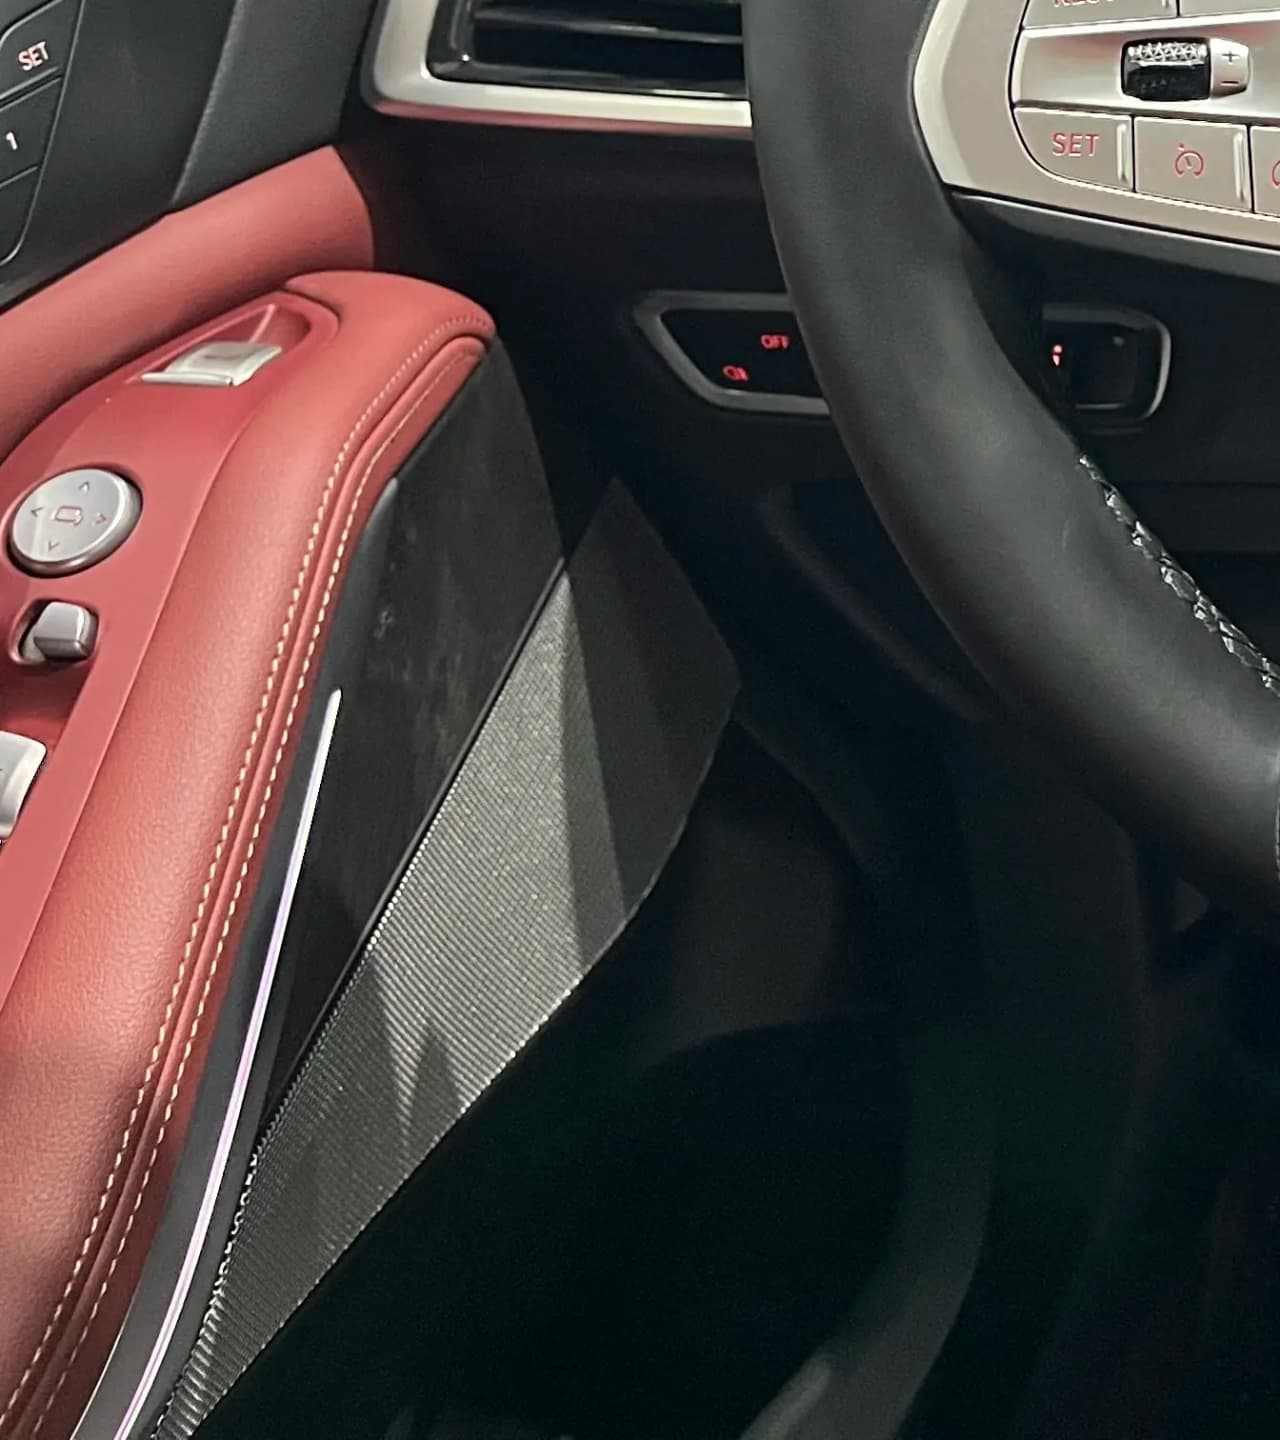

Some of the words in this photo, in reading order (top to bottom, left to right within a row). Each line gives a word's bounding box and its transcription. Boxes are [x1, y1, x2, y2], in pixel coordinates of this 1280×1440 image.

[18, 41, 49, 71] SET
[5, 131, 18, 151] 1
[1052, 133, 1099, 157] SET
[761, 334, 789, 349] OFF
